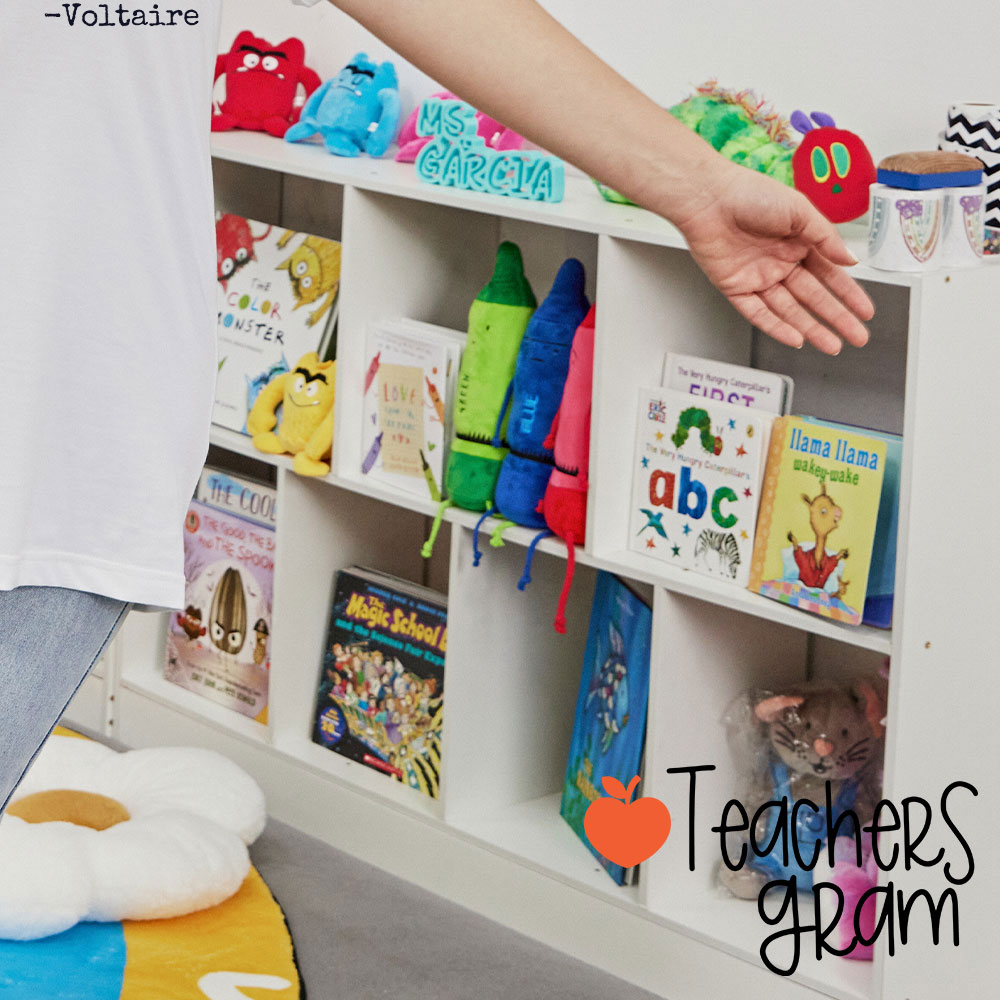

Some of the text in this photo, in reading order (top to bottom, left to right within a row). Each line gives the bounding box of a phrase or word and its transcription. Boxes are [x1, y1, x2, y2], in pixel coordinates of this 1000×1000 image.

[417, 142, 556, 200] GARCIA
[227, 291, 282, 320] COLOR
[789, 427, 879, 471] llama llama
[793, 458, 860, 486] wakey-wake
[648, 465, 739, 530] abc
[346, 592, 391, 628] Magic
[389, 607, 441, 647] School
